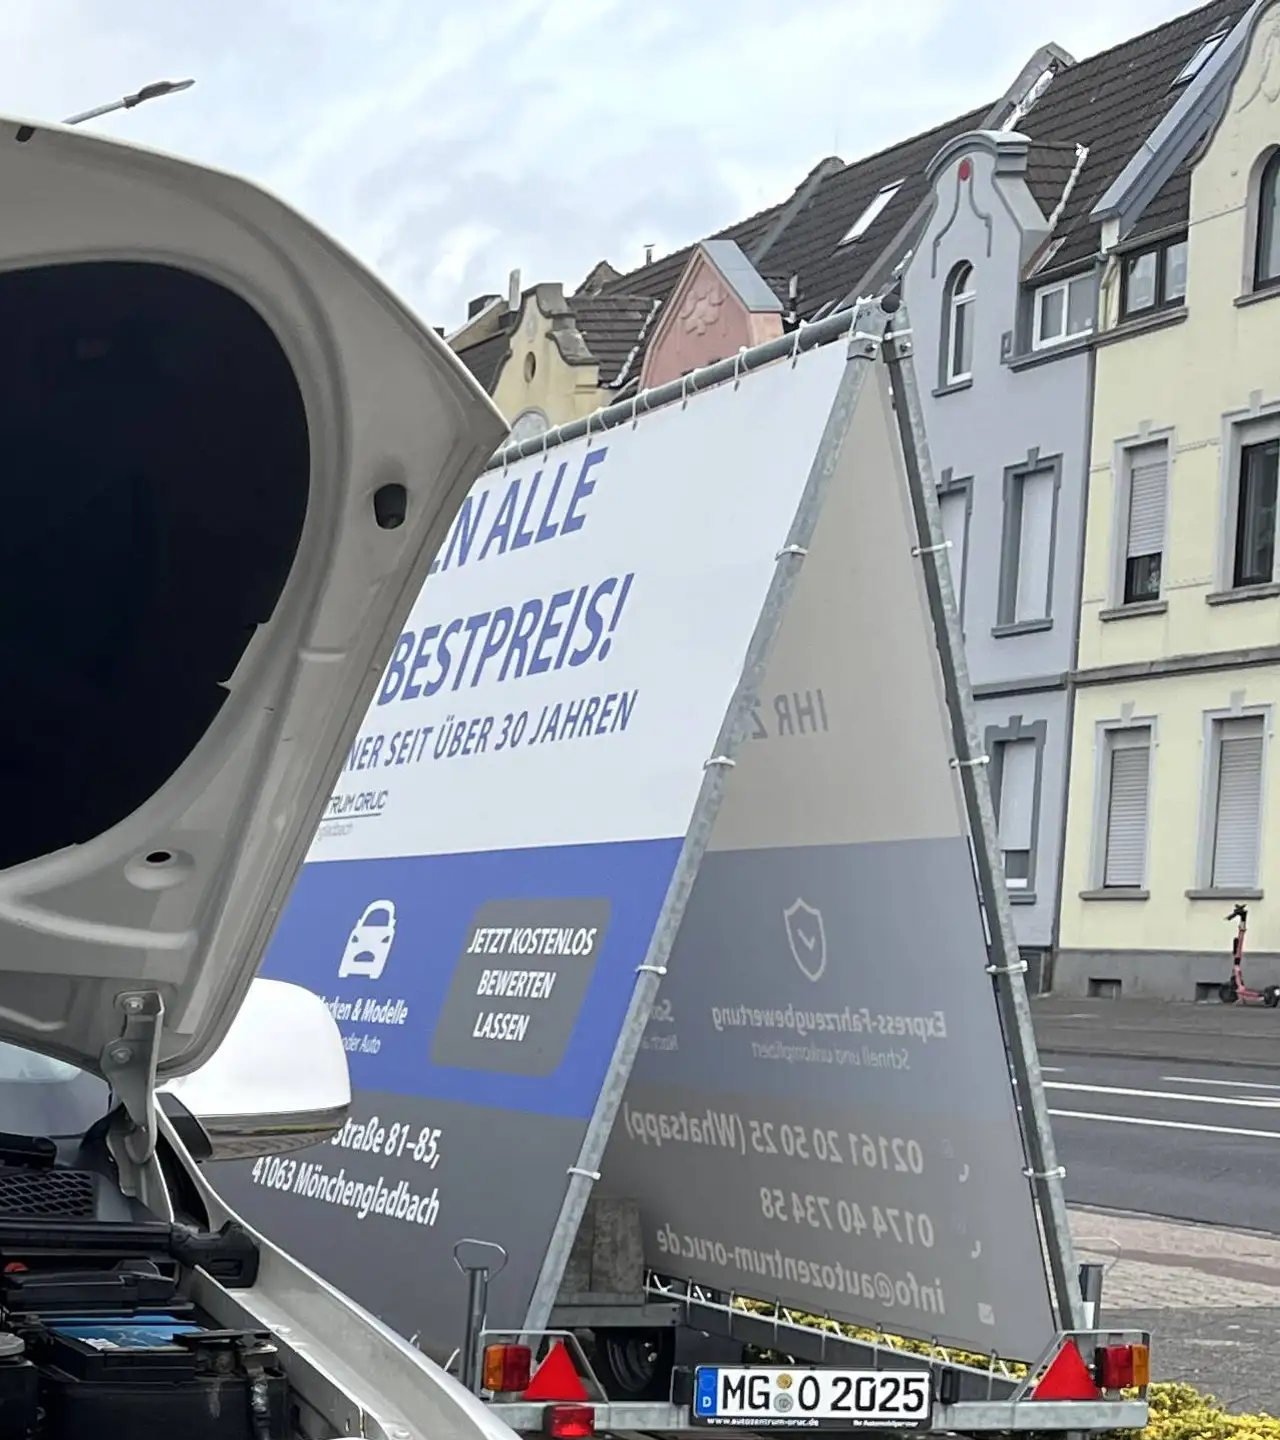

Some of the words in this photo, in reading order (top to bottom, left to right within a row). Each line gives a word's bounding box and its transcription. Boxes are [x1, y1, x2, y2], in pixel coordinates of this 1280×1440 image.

[478, 446, 609, 561] ALLE
[377, 573, 634, 706] BESTPREIS!
[384, 726, 433, 767] SEIT
[434, 714, 494, 760] ÜBER
[494, 711, 528, 751] 30
[528, 689, 638, 746] JAHREN
[467, 927, 512, 954] JETZT
[508, 927, 597, 956] KOSTENLOS
[477, 969, 556, 999] BEWERTEN
[351, 998, 363, 1021] &
[361, 998, 409, 1025] Modelle
[473, 1012, 530, 1041] LASSEN
[360, 1034, 381, 1055] Auto
[252, 1156, 297, 1192] 41063
[293, 1162, 440, 1227] Mönchengladbach
[702, 1396, 711, 1408] D
[722, 1375, 770, 1411] MG
[798, 1375, 820, 1412] O
[831, 1376, 925, 1412] 2025
